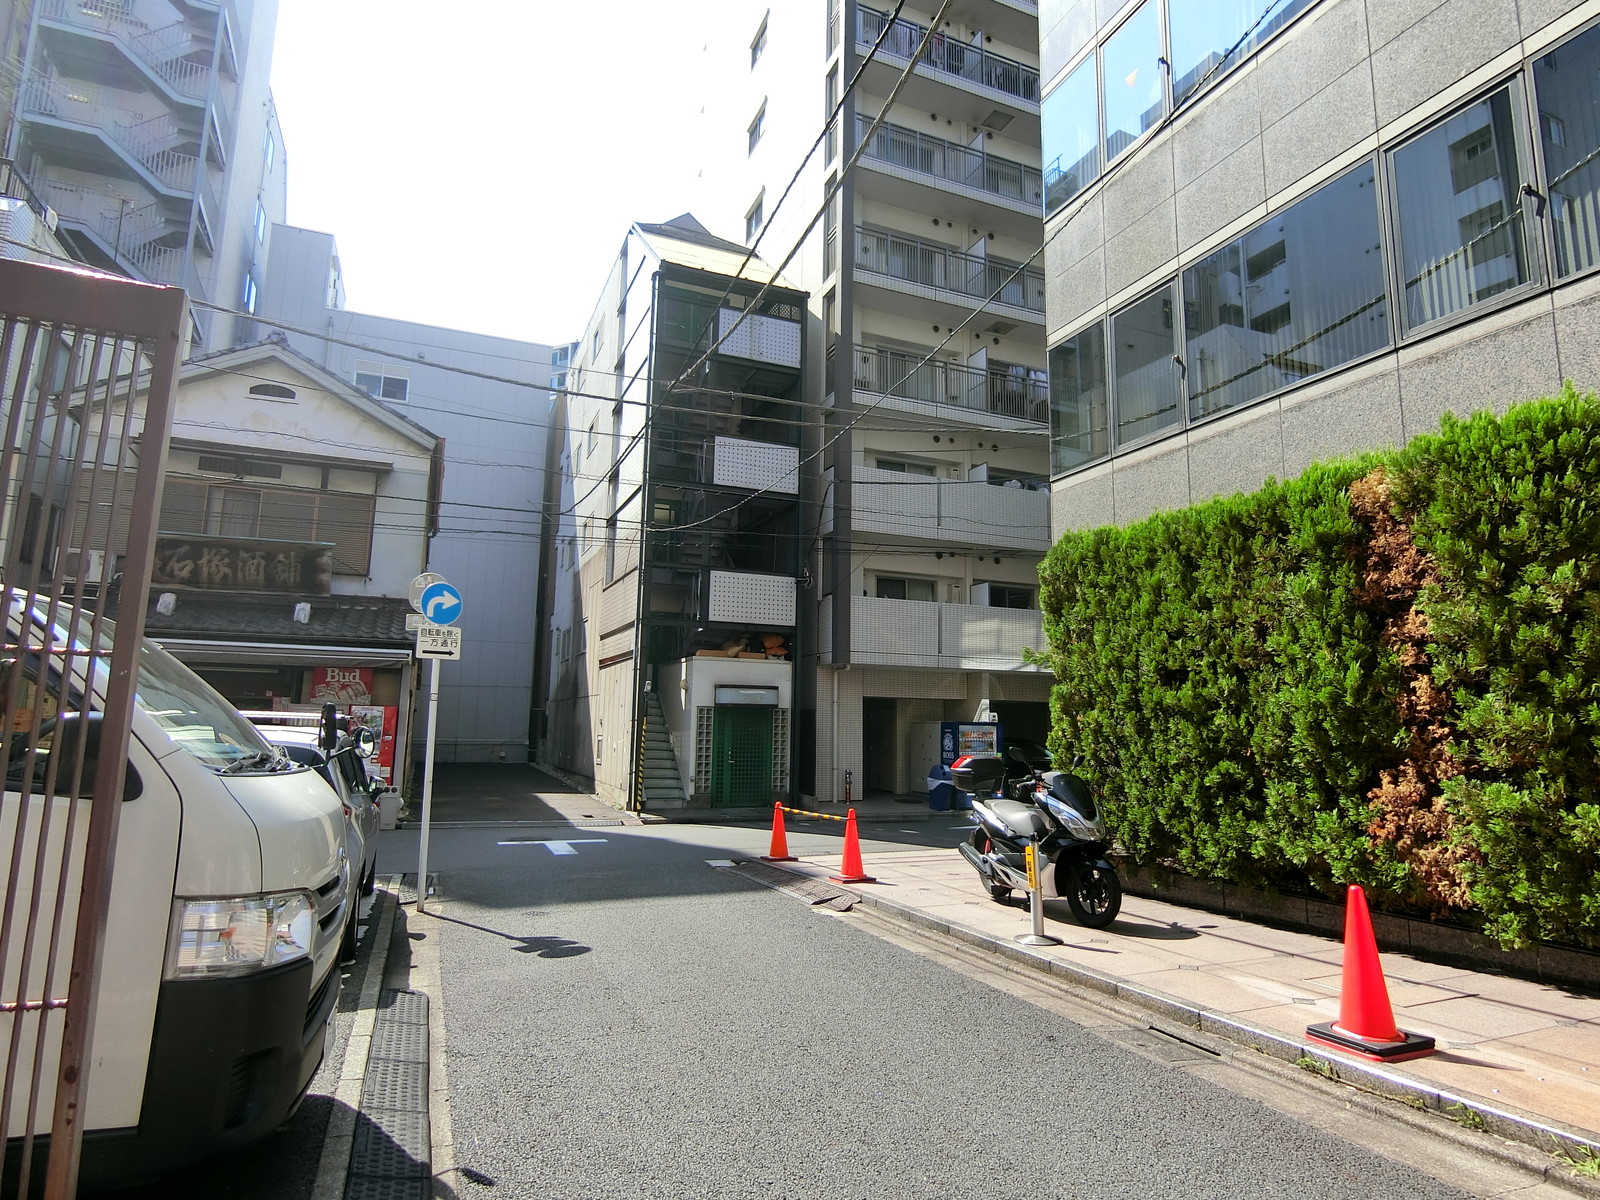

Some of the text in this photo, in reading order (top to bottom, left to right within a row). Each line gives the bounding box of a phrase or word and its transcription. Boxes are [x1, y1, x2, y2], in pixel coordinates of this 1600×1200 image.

[420, 628, 459, 638] 自転車を除く
[420, 639, 459, 648] 一方通行
[326, 667, 360, 682] Bud
[943, 751, 954, 759] BOSS
